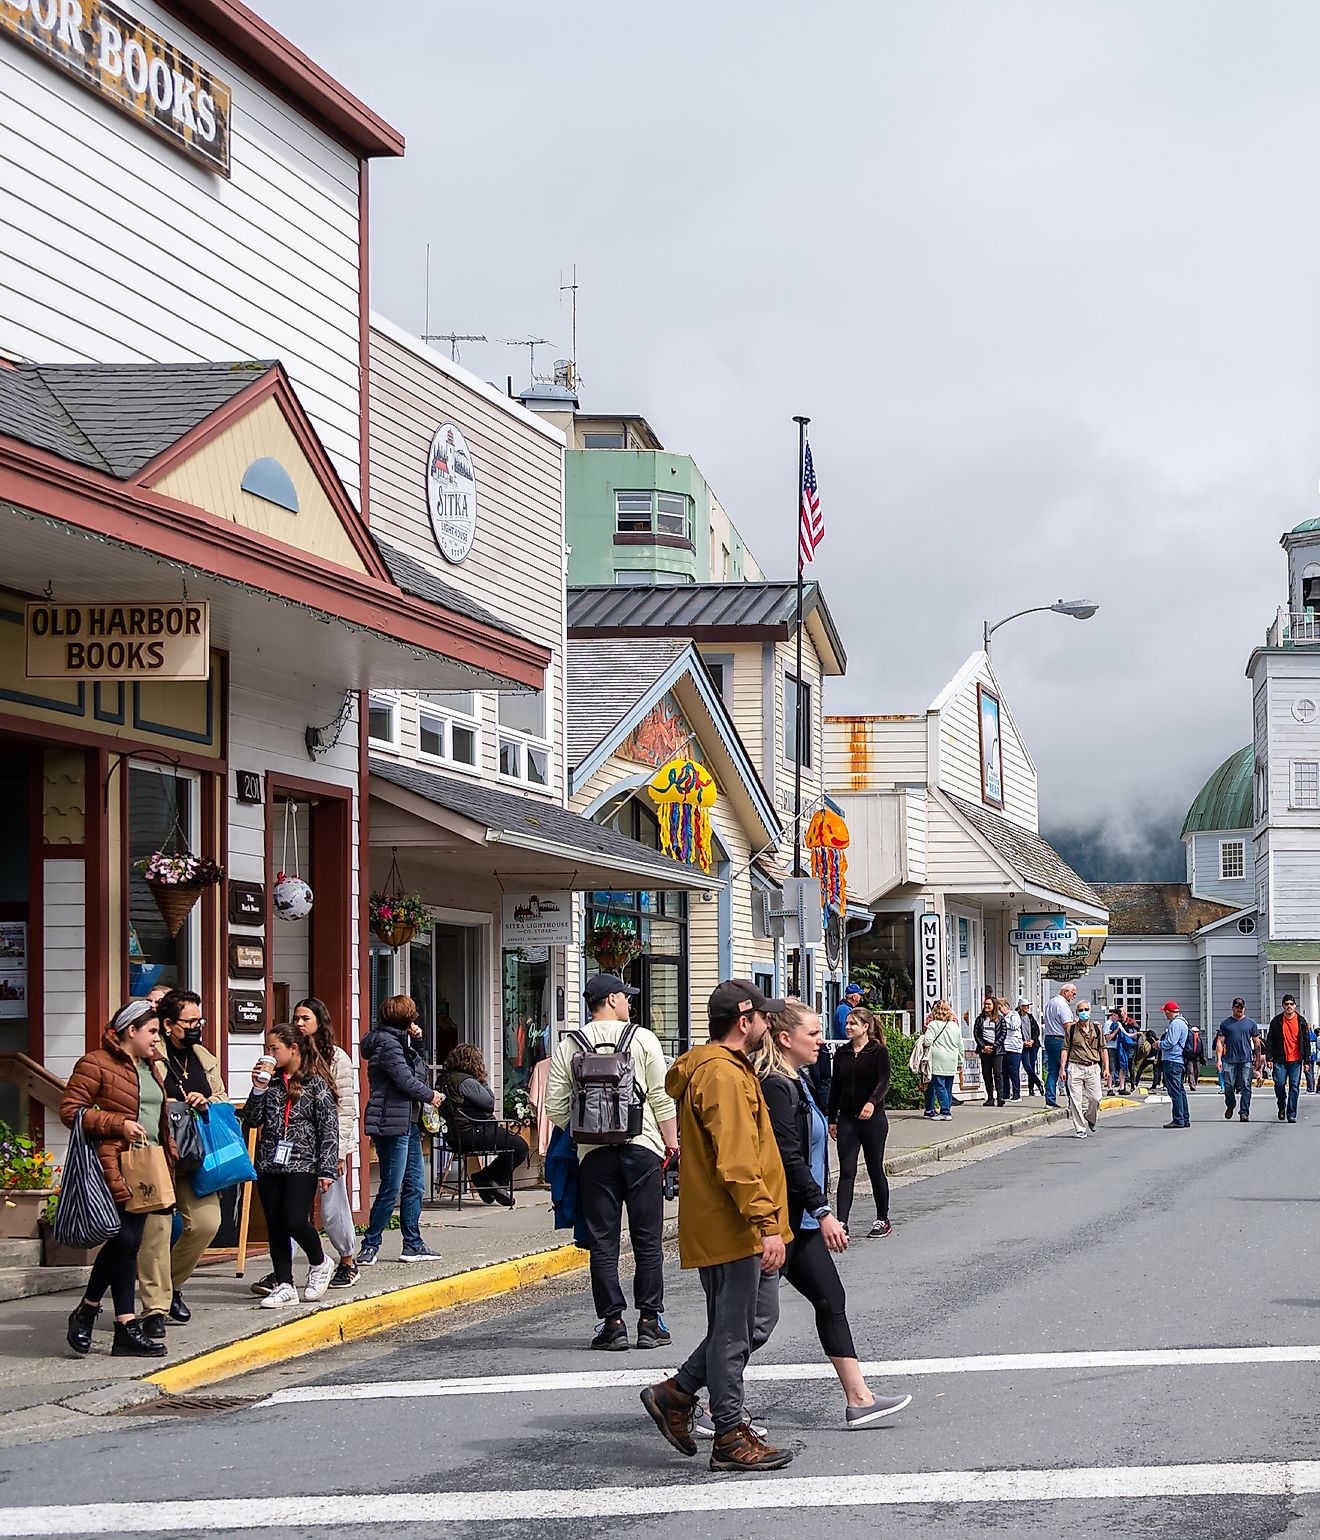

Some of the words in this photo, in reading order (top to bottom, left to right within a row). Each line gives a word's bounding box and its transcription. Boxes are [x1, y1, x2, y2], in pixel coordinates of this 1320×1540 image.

[99, 16, 217, 143] BOOKS
[437, 486, 468, 517] SITKA
[32, 608, 82, 636] OLD
[89, 607, 201, 636] HARBOR
[67, 641, 165, 669] BOOKS
[244, 775, 260, 799] 201
[526, 921, 569, 929] LIGHTHOUSE
[1015, 931, 1041, 940] Blue
[1043, 931, 1072, 941] Eyed
[1025, 942, 1062, 951] BEAR
